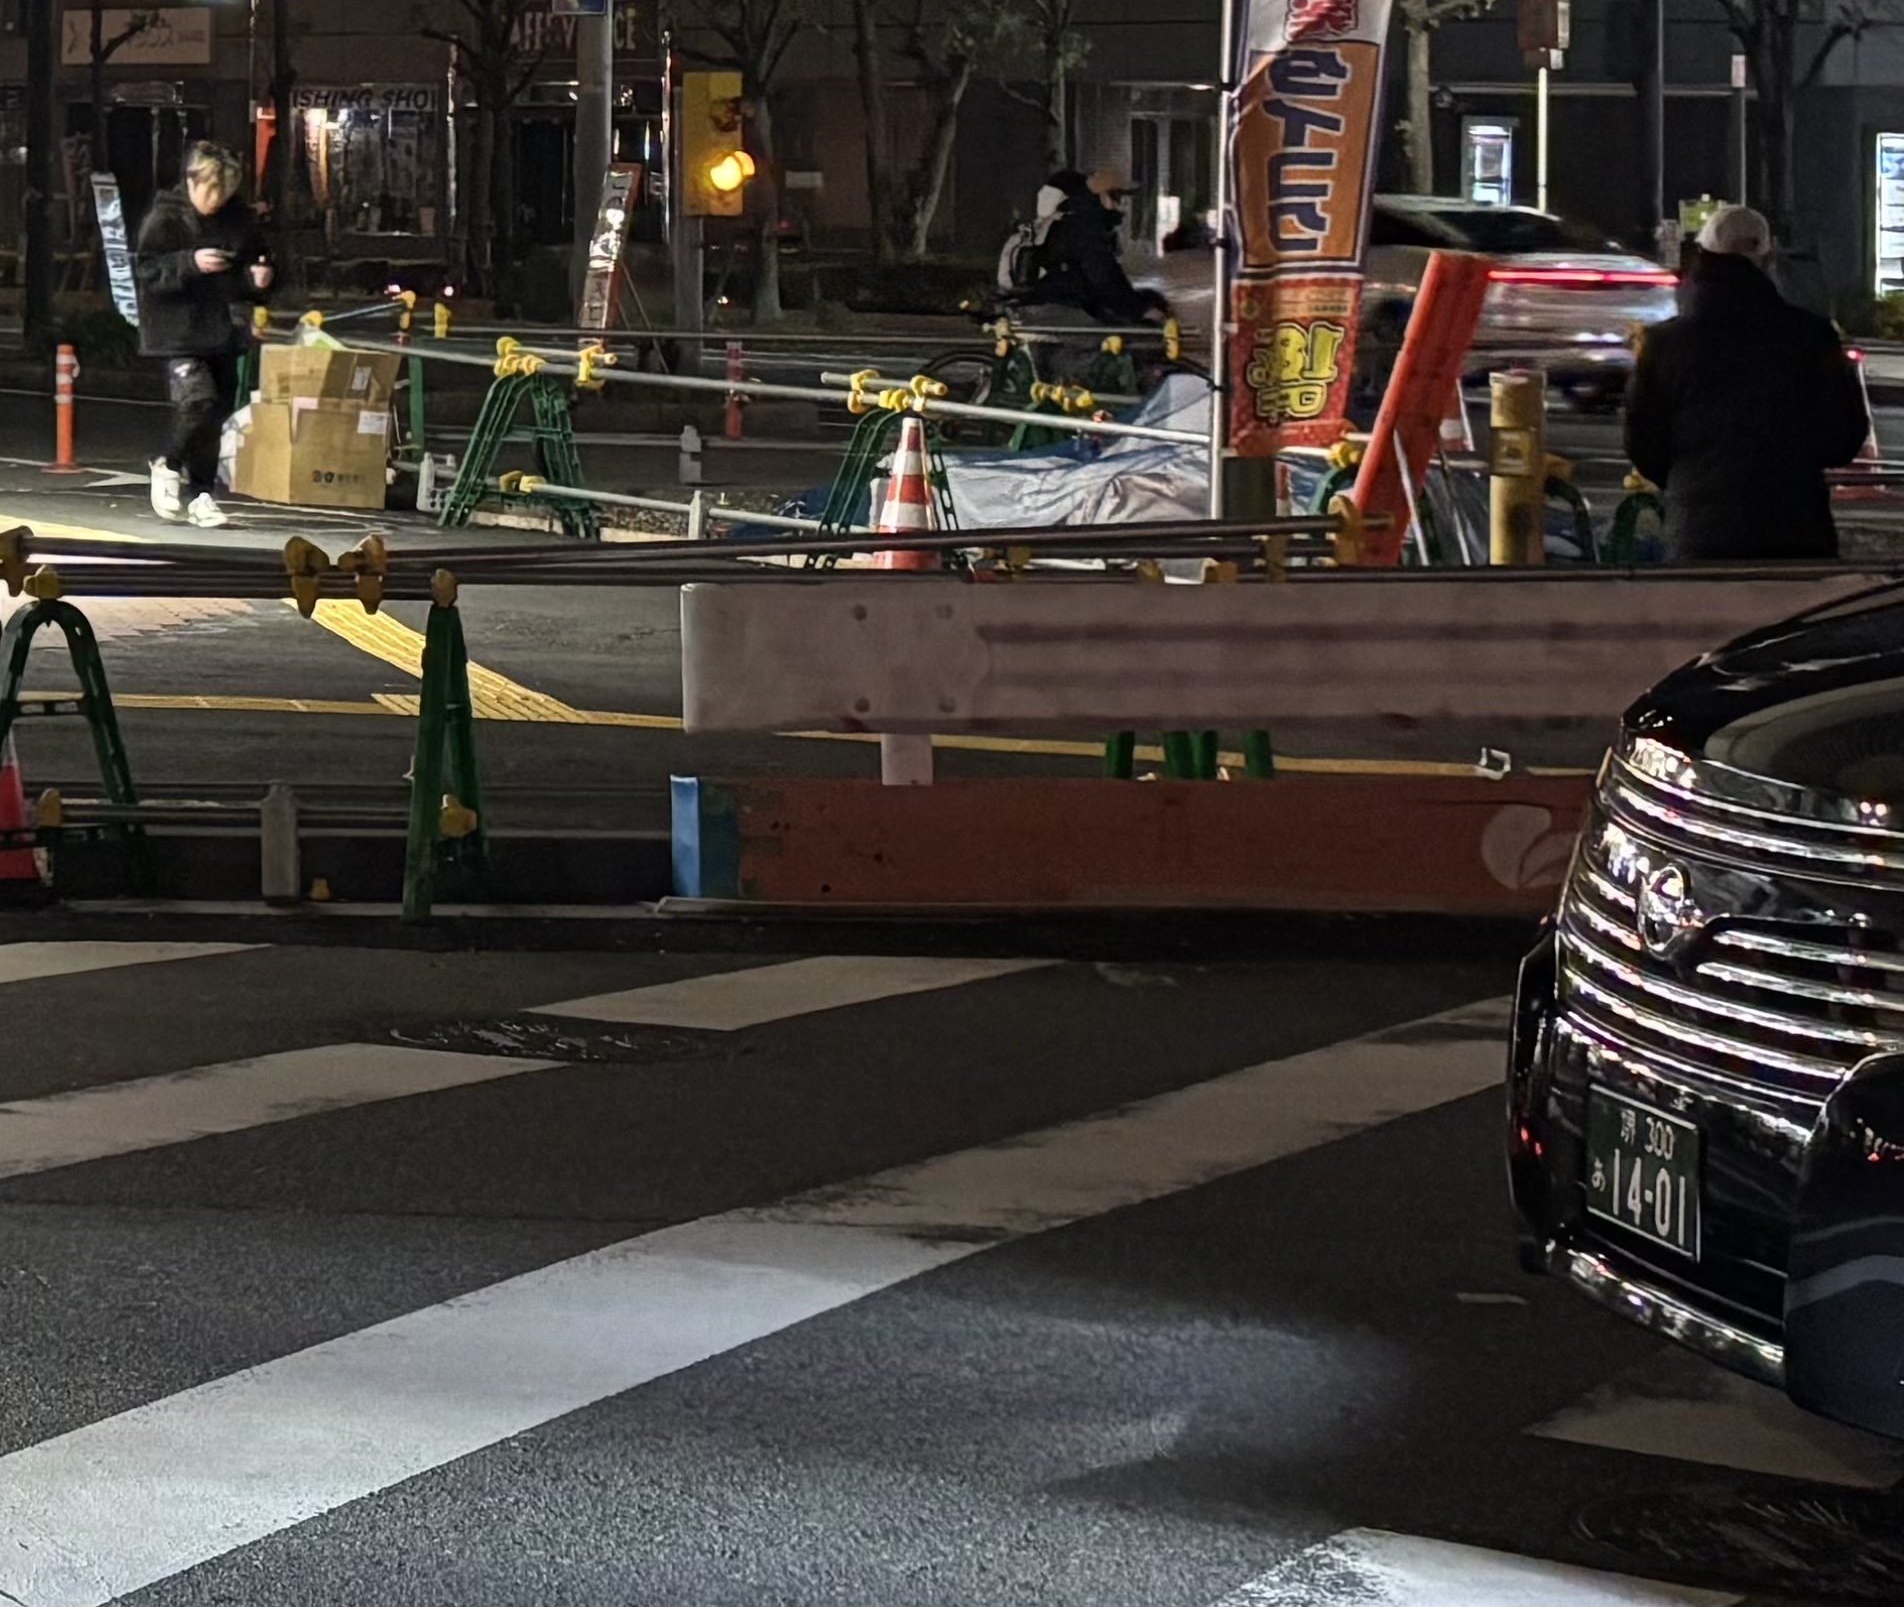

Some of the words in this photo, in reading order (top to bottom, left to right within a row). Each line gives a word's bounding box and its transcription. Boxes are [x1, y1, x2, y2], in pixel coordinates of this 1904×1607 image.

[382, 88, 437, 109] SHO
[1644, 1116, 1675, 1161] 300
[1613, 1148, 1686, 1246] 14-01
